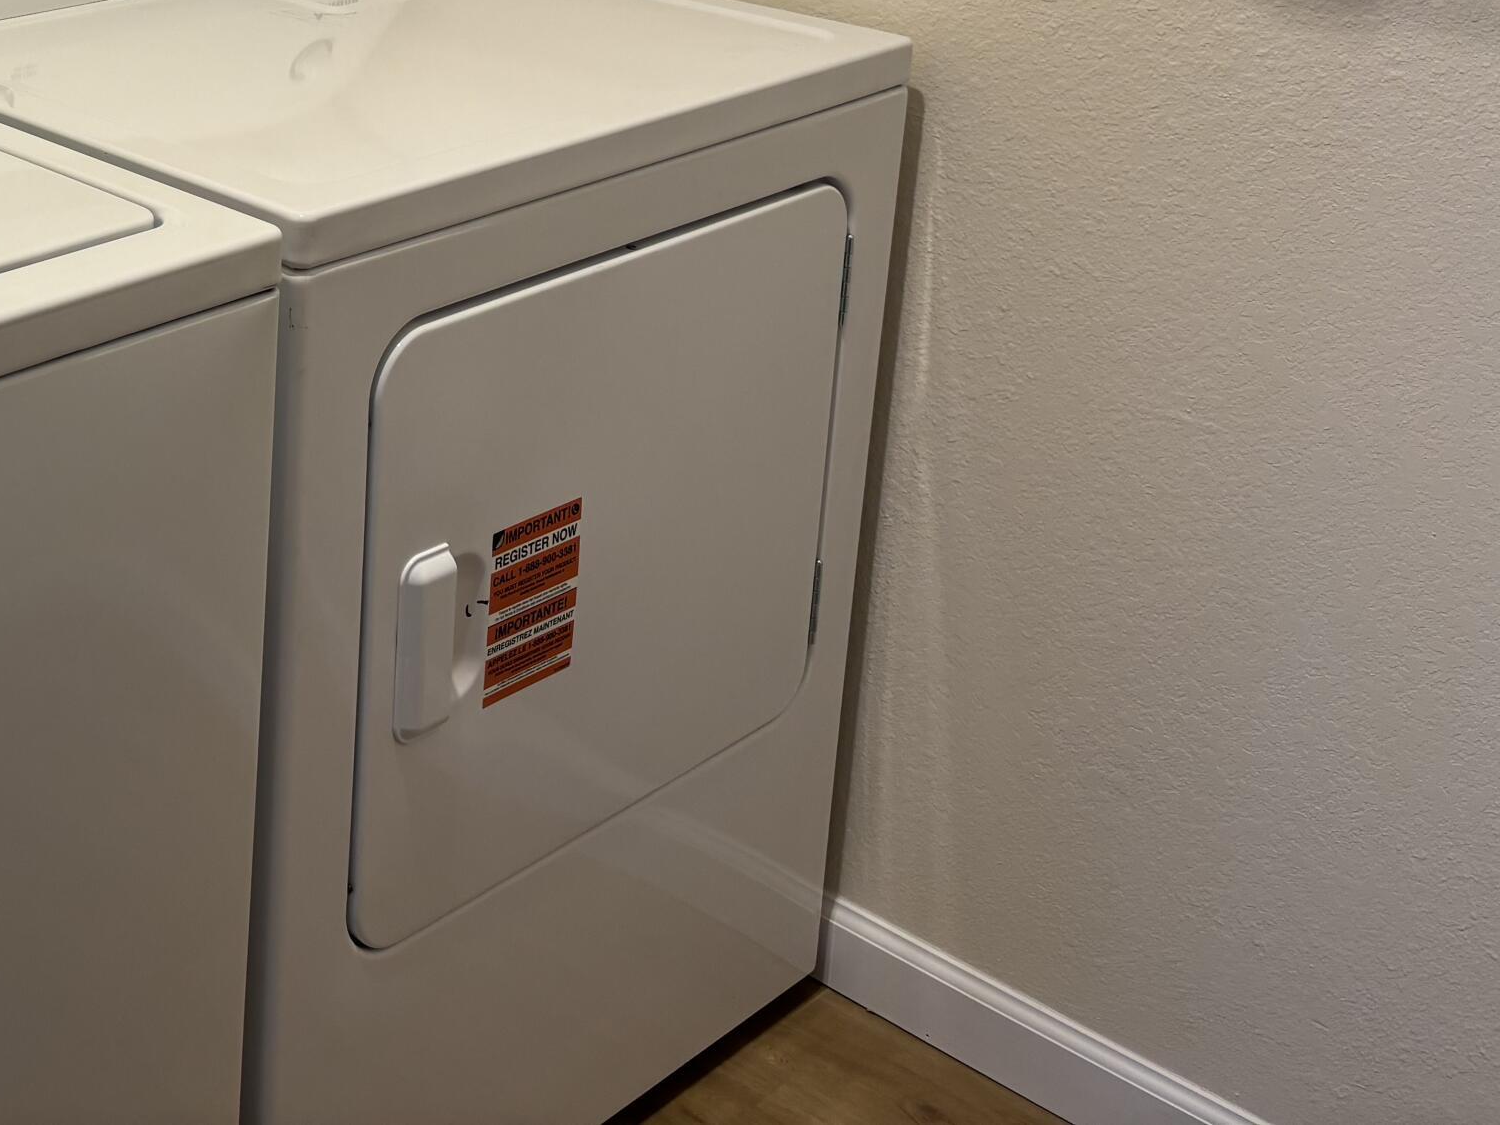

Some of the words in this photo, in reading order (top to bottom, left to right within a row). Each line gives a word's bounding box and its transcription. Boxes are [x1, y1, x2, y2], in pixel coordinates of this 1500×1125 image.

[506, 506, 571, 544] IMPORTANT!
[495, 536, 549, 570] REGISTER
[552, 523, 578, 545] NOW
[493, 570, 517, 587] CALL
[487, 629, 532, 656] ENREGISTREZ
[533, 610, 574, 635] MAINTENANT
